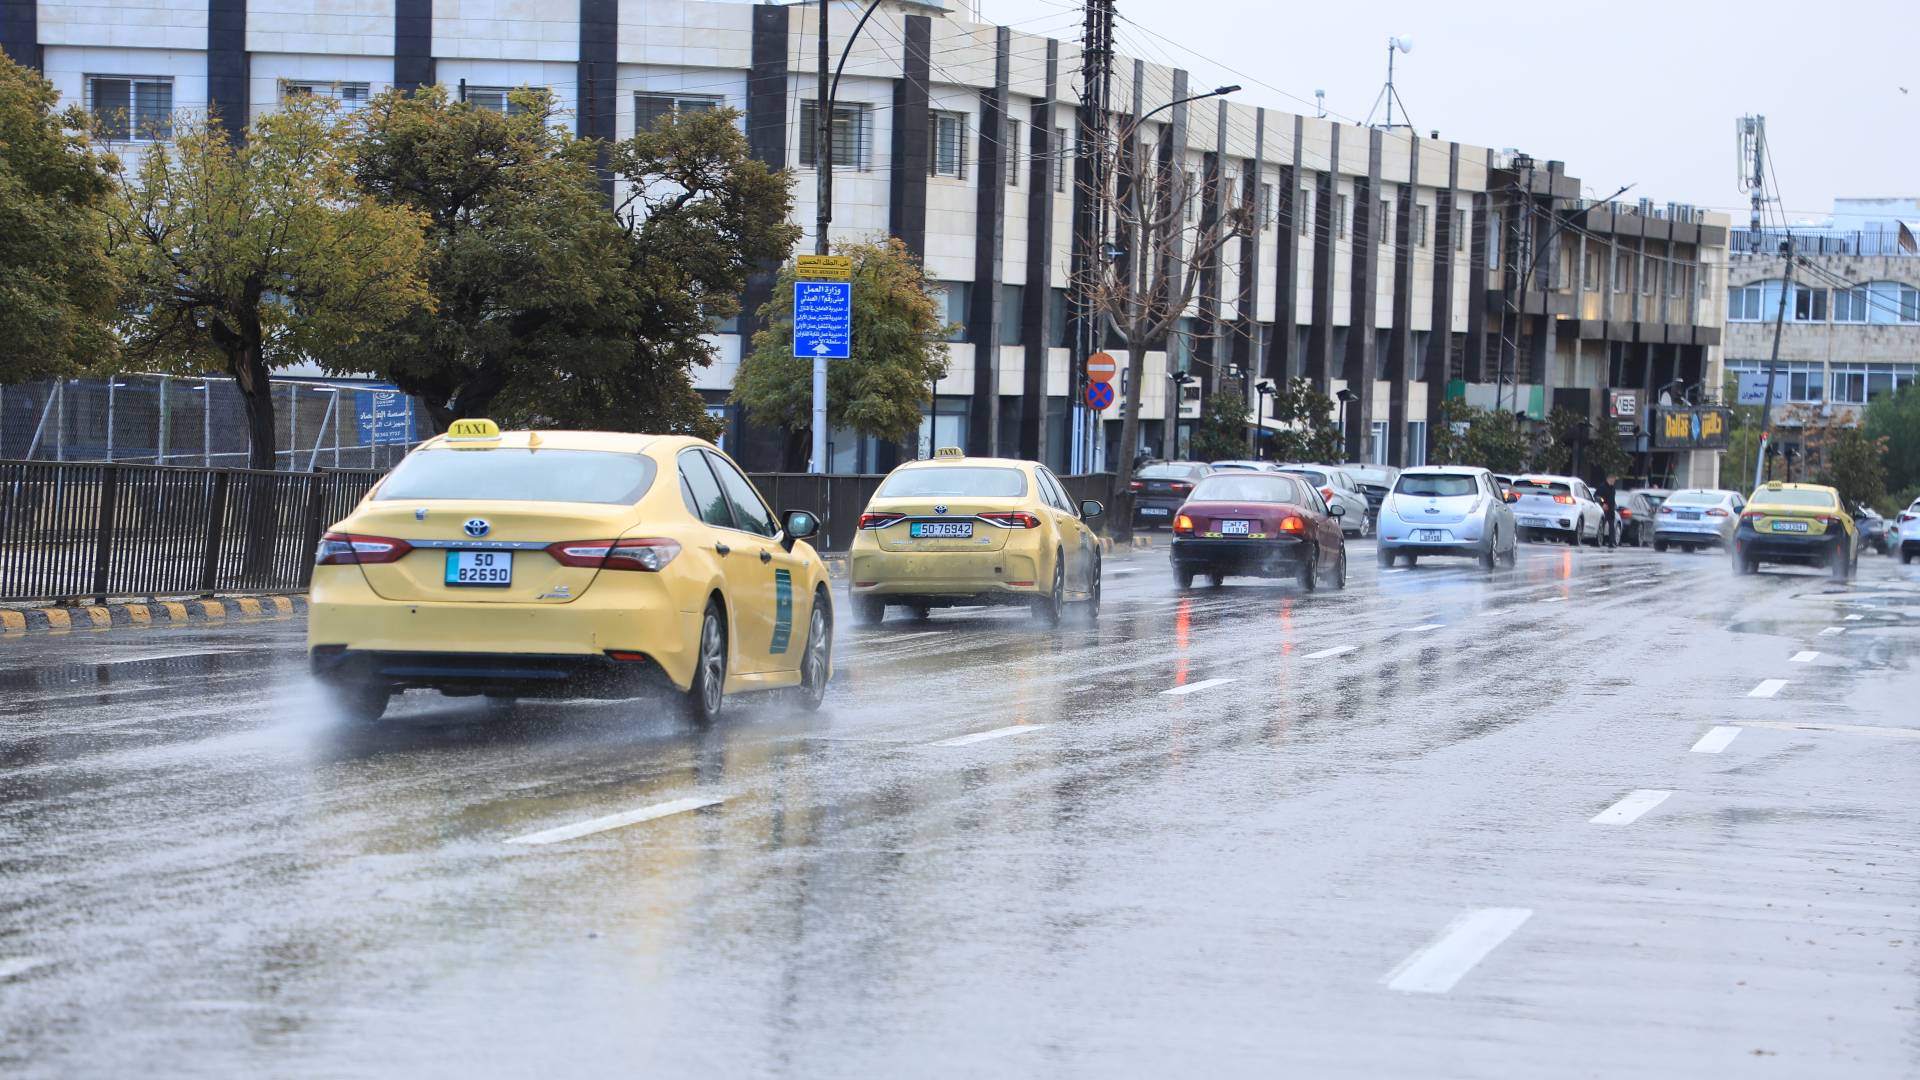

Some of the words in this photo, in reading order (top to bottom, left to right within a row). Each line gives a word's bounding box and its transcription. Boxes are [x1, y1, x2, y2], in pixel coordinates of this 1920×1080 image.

[803, 285, 824, 294] العمل
[824, 286, 841, 296] وزارة
[800, 295, 818, 304] العبدلي
[455, 423, 486, 434] TAXI
[1665, 412, 1689, 438] Dallas
[939, 448, 958, 456] TAXI
[475, 554, 493, 566] 50
[459, 568, 508, 581] 82690
